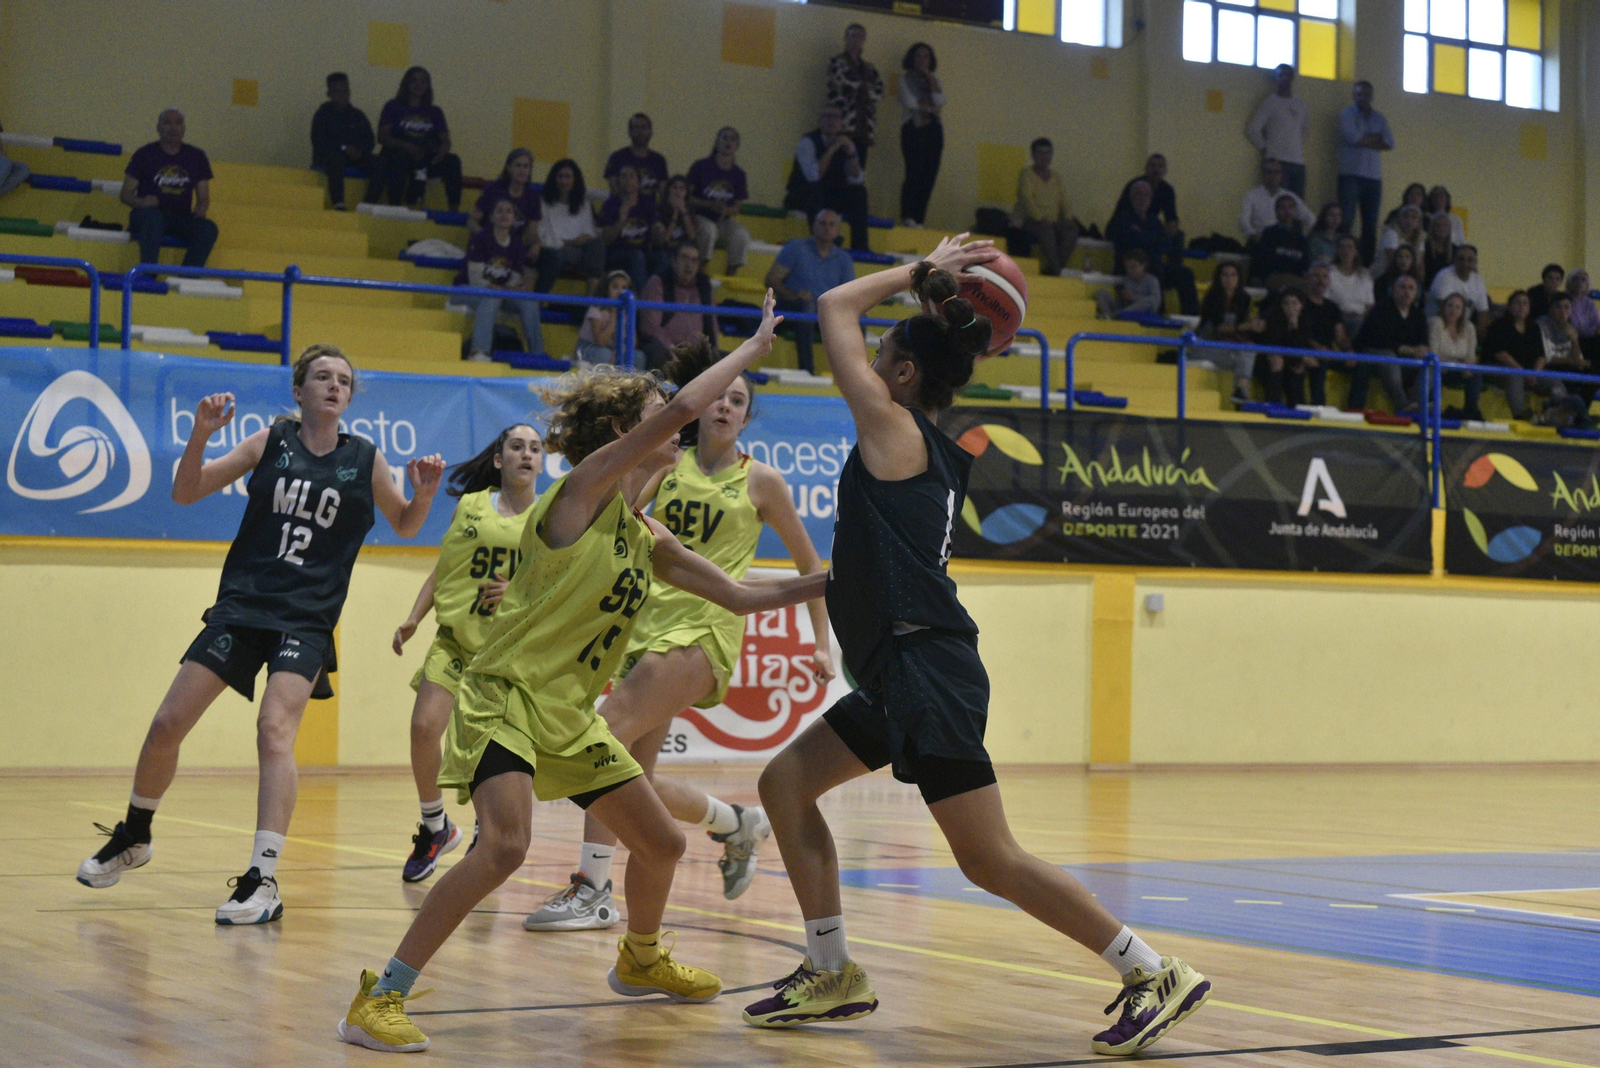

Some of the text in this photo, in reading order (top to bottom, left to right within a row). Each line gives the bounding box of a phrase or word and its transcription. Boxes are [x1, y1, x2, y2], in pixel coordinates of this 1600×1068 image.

[972, 288, 1010, 321] molten
[1058, 441, 1220, 493] Andalucía
[272, 477, 341, 529] MLG
[1061, 501, 1206, 522] Región Europea del
[665, 498, 725, 544] SEV
[1062, 522, 1180, 540] DEPORTE 2021
[1268, 521, 1379, 539] Junta de Andalucía
[1554, 523, 1596, 542] Región
[277, 521, 313, 566] 12
[1554, 543, 1600, 558] DEPOR
[594, 754, 618, 769] vive
